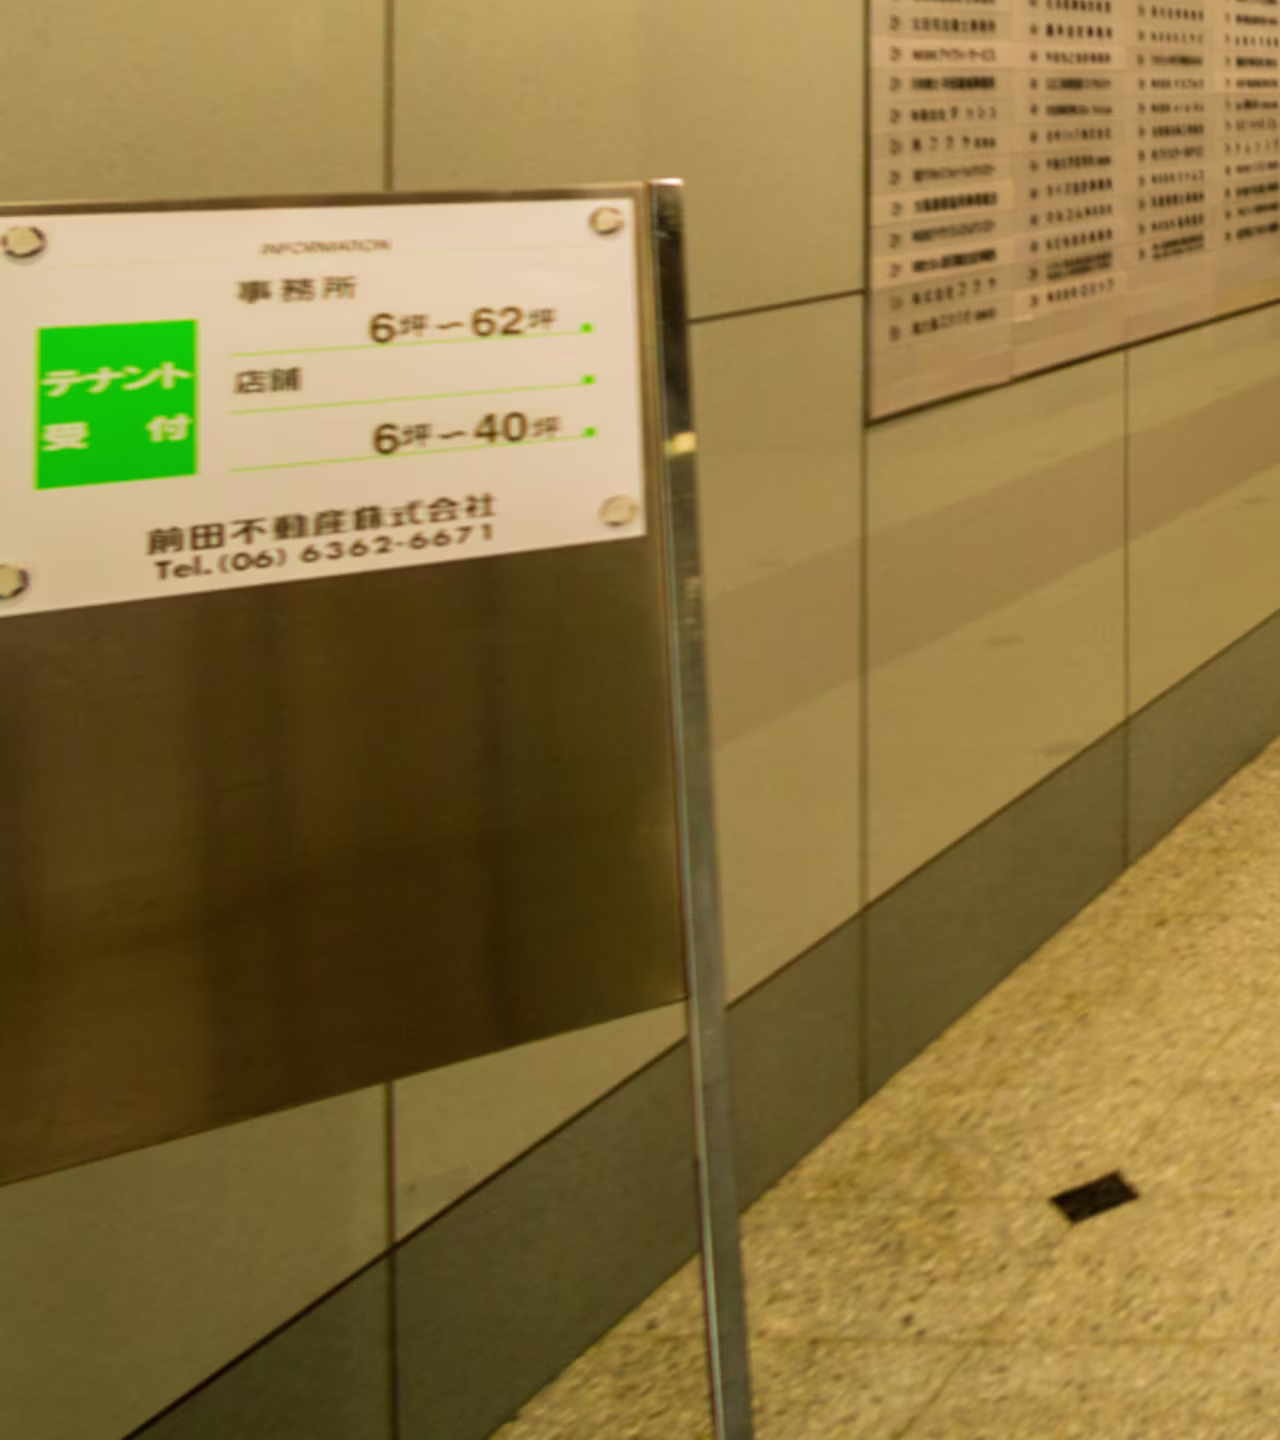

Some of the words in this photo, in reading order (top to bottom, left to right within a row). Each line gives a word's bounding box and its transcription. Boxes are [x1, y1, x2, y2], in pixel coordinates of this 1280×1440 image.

[260, 239, 391, 255] INFORMATION
[237, 276, 356, 303] 事務所
[41, 362, 193, 397] テナント
[235, 367, 301, 394] 店舗
[147, 493, 495, 555] 前田不動産株式会社
[300, 524, 494, 564] 6362-6671
